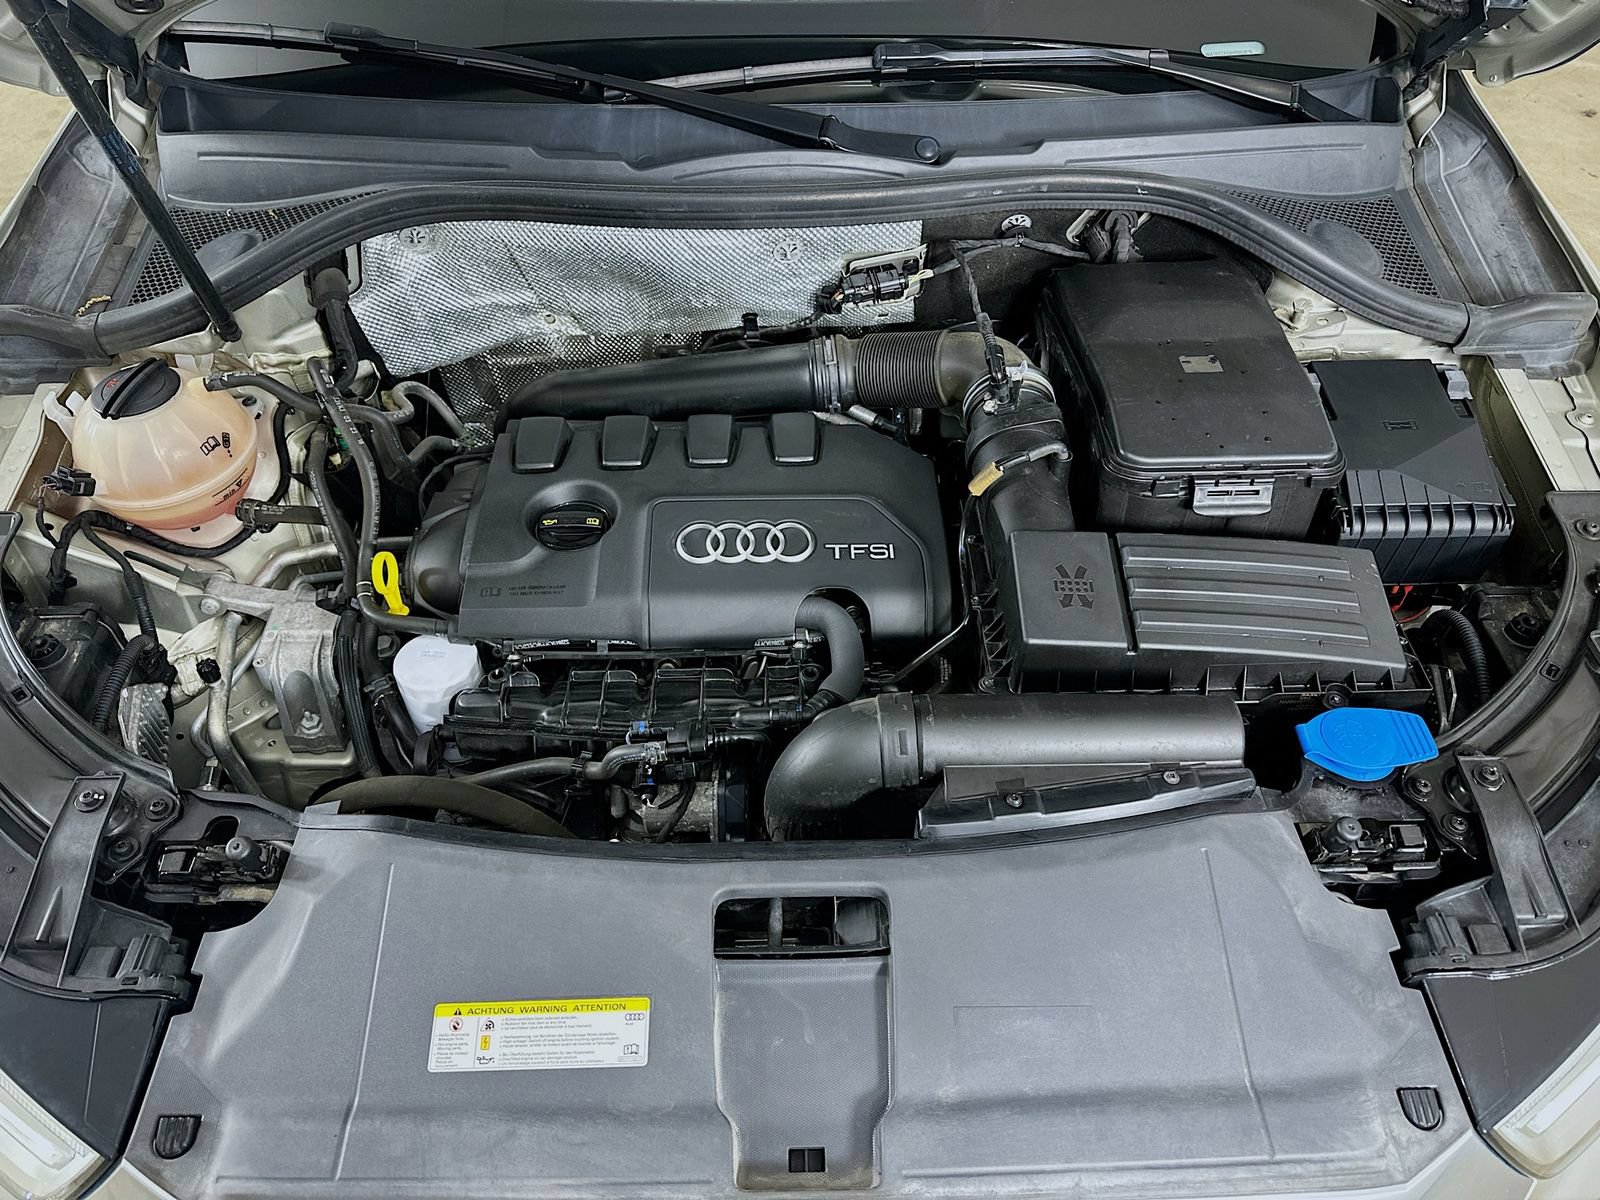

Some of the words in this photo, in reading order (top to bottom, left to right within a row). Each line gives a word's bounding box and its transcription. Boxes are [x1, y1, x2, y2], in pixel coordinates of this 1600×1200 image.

[223, 488, 236, 501] min
[824, 543, 896, 560] TFSI
[466, 1006, 514, 1015] ACHTUNG
[519, 1004, 567, 1014] WARNING
[573, 1003, 626, 1011] ATTENTION
